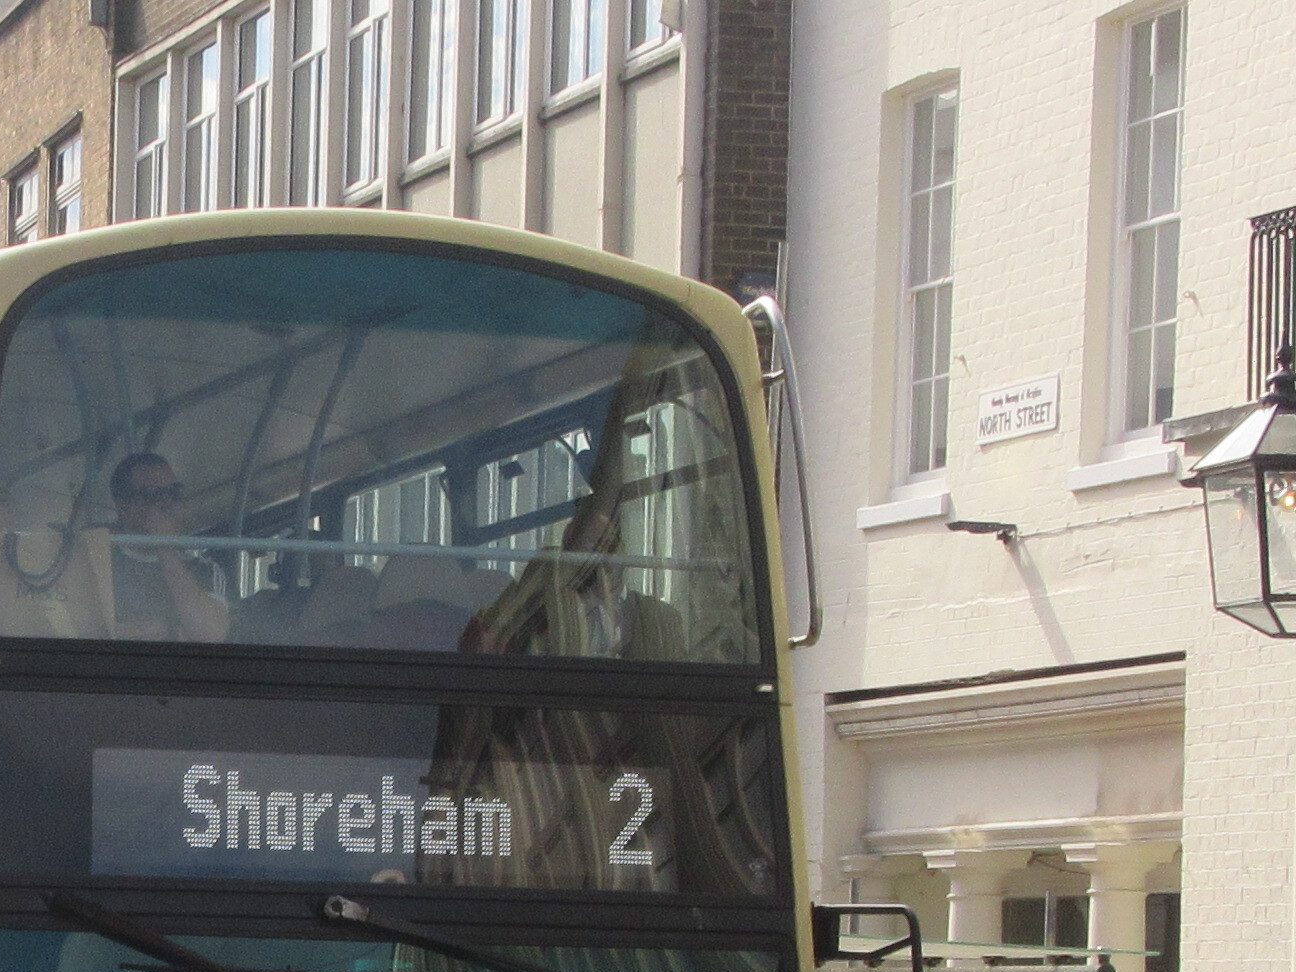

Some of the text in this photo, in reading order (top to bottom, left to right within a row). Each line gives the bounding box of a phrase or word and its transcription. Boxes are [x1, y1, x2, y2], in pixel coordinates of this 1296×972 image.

[979, 401, 1053, 437] NORTH STREET
[182, 765, 653, 866] Shoreham 2
